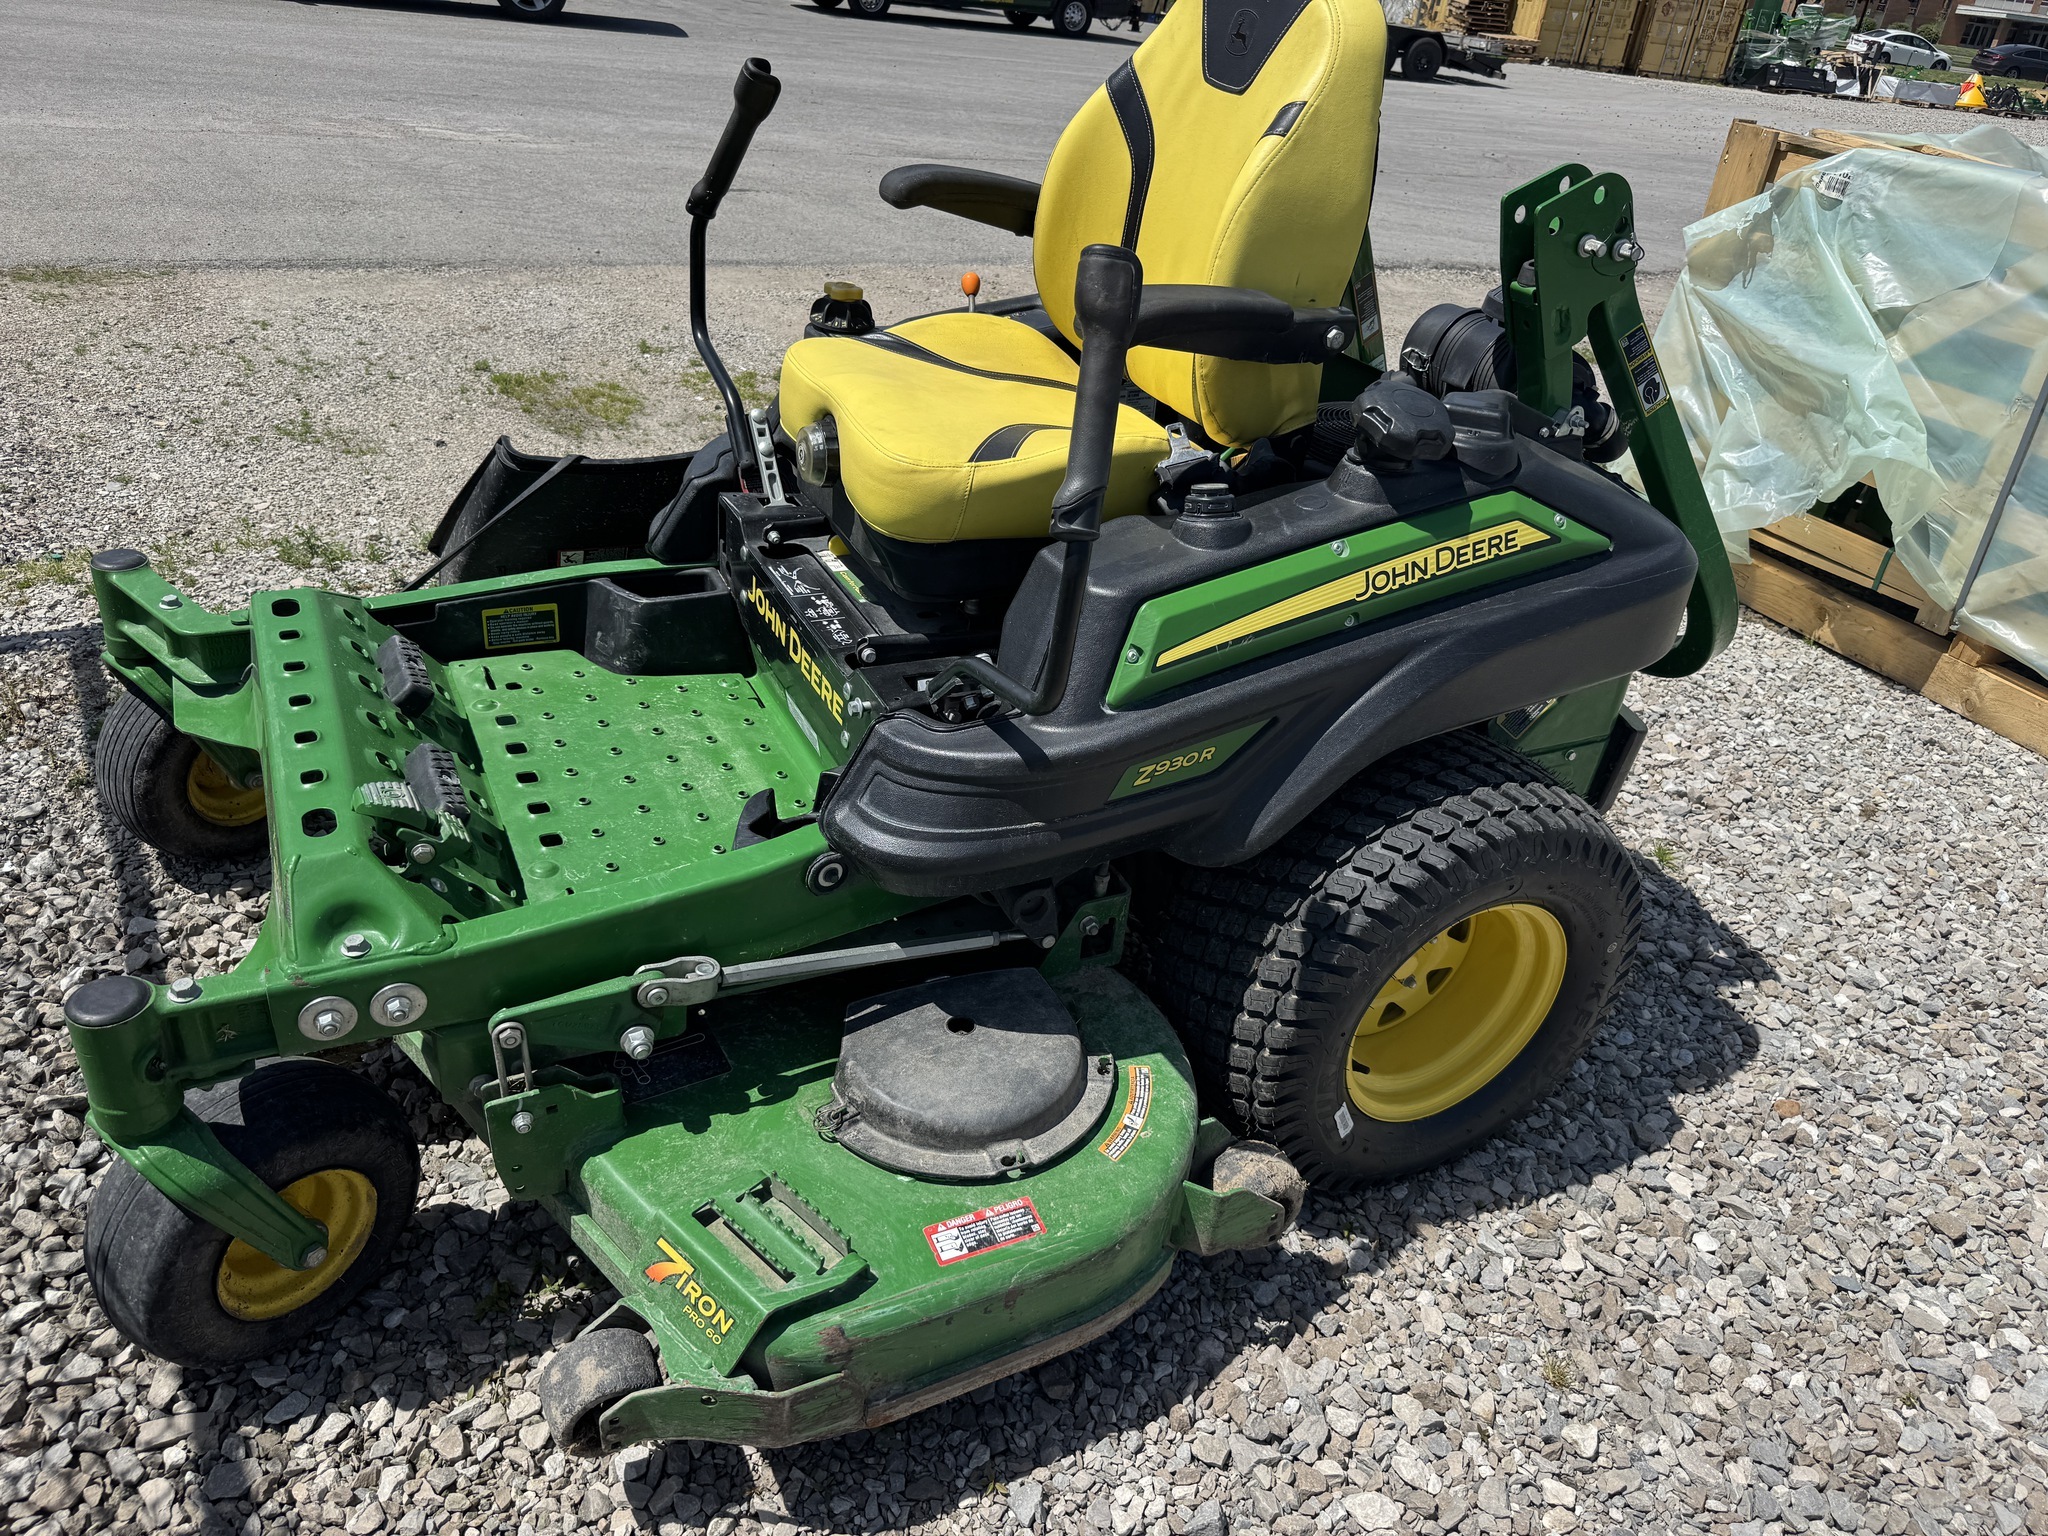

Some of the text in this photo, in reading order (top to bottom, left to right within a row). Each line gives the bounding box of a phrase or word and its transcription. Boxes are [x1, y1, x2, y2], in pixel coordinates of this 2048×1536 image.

[1355, 529, 1522, 601] JOHN DEERE
[747, 575, 786, 647] JOHN
[788, 627, 844, 725] DEERE
[1132, 746, 1216, 788] Z930R
[946, 1214, 976, 1227] DANGER
[993, 1198, 1024, 1213] PELIGRO
[682, 1304, 722, 1345] PRO 60
